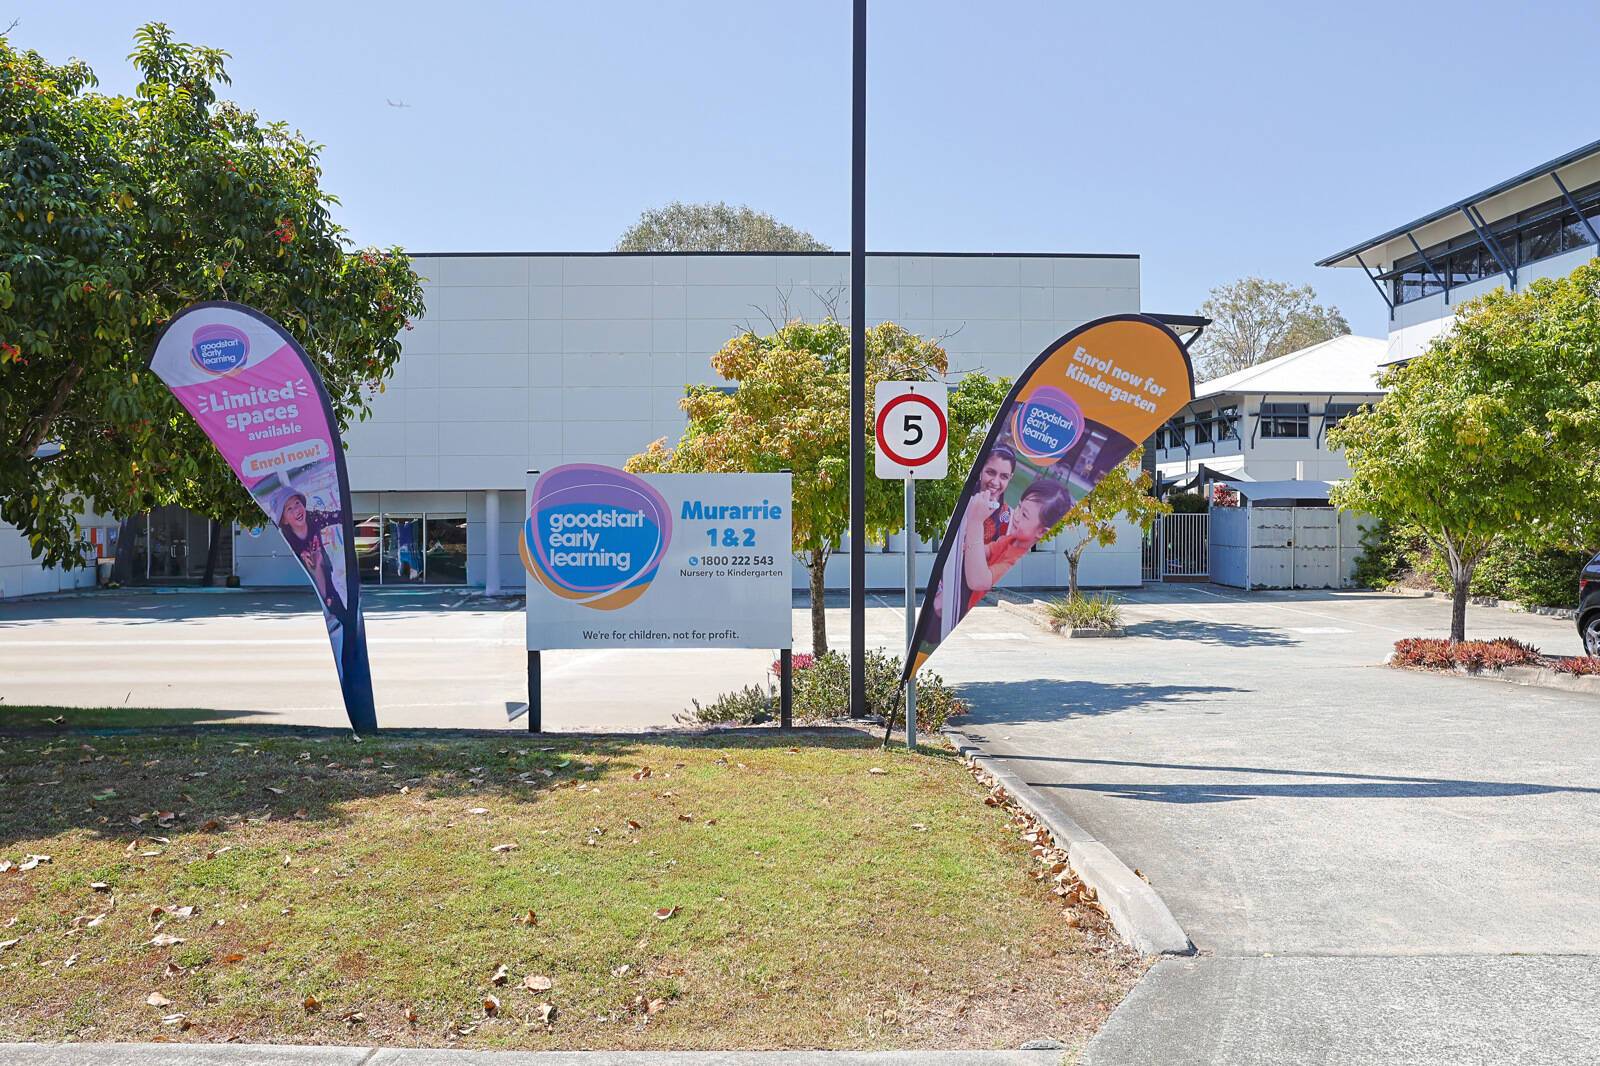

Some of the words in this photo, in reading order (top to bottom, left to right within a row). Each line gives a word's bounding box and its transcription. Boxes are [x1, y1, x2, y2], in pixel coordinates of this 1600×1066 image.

[200, 339, 238, 351] goodstart
[201, 348, 222, 358] early
[203, 354, 236, 364] learning
[1073, 346, 1113, 375] Enrol
[1111, 366, 1143, 388] now
[1143, 377, 1167, 397] for
[209, 380, 296, 412] Limited
[1065, 363, 1157, 414] Kindergarten
[225, 404, 299, 432] spaces
[1026, 416, 1050, 432] early
[1029, 407, 1073, 430] goodstart
[248, 422, 302, 441] available
[903, 415, 923, 445] 5
[1022, 424, 1059, 449] learning
[250, 452, 286, 472] Enrol
[287, 444, 321, 465] now!
[681, 499, 782, 520] Murarrie
[549, 509, 645, 533] goodstart
[549, 529, 600, 551] early
[550, 548, 631, 572] learning
[701, 556, 728, 566] 1800
[731, 556, 751, 566] 222
[753, 556, 774, 566] 543
[680, 569, 714, 578] Nursery
[716, 569, 725, 577] to
[727, 568, 783, 578] Kindergarten
[583, 630, 610, 640] We're
[612, 630, 626, 640] for
[673, 630, 690, 640] not
[692, 630, 706, 640] for
[708, 629, 740, 641] profit.
